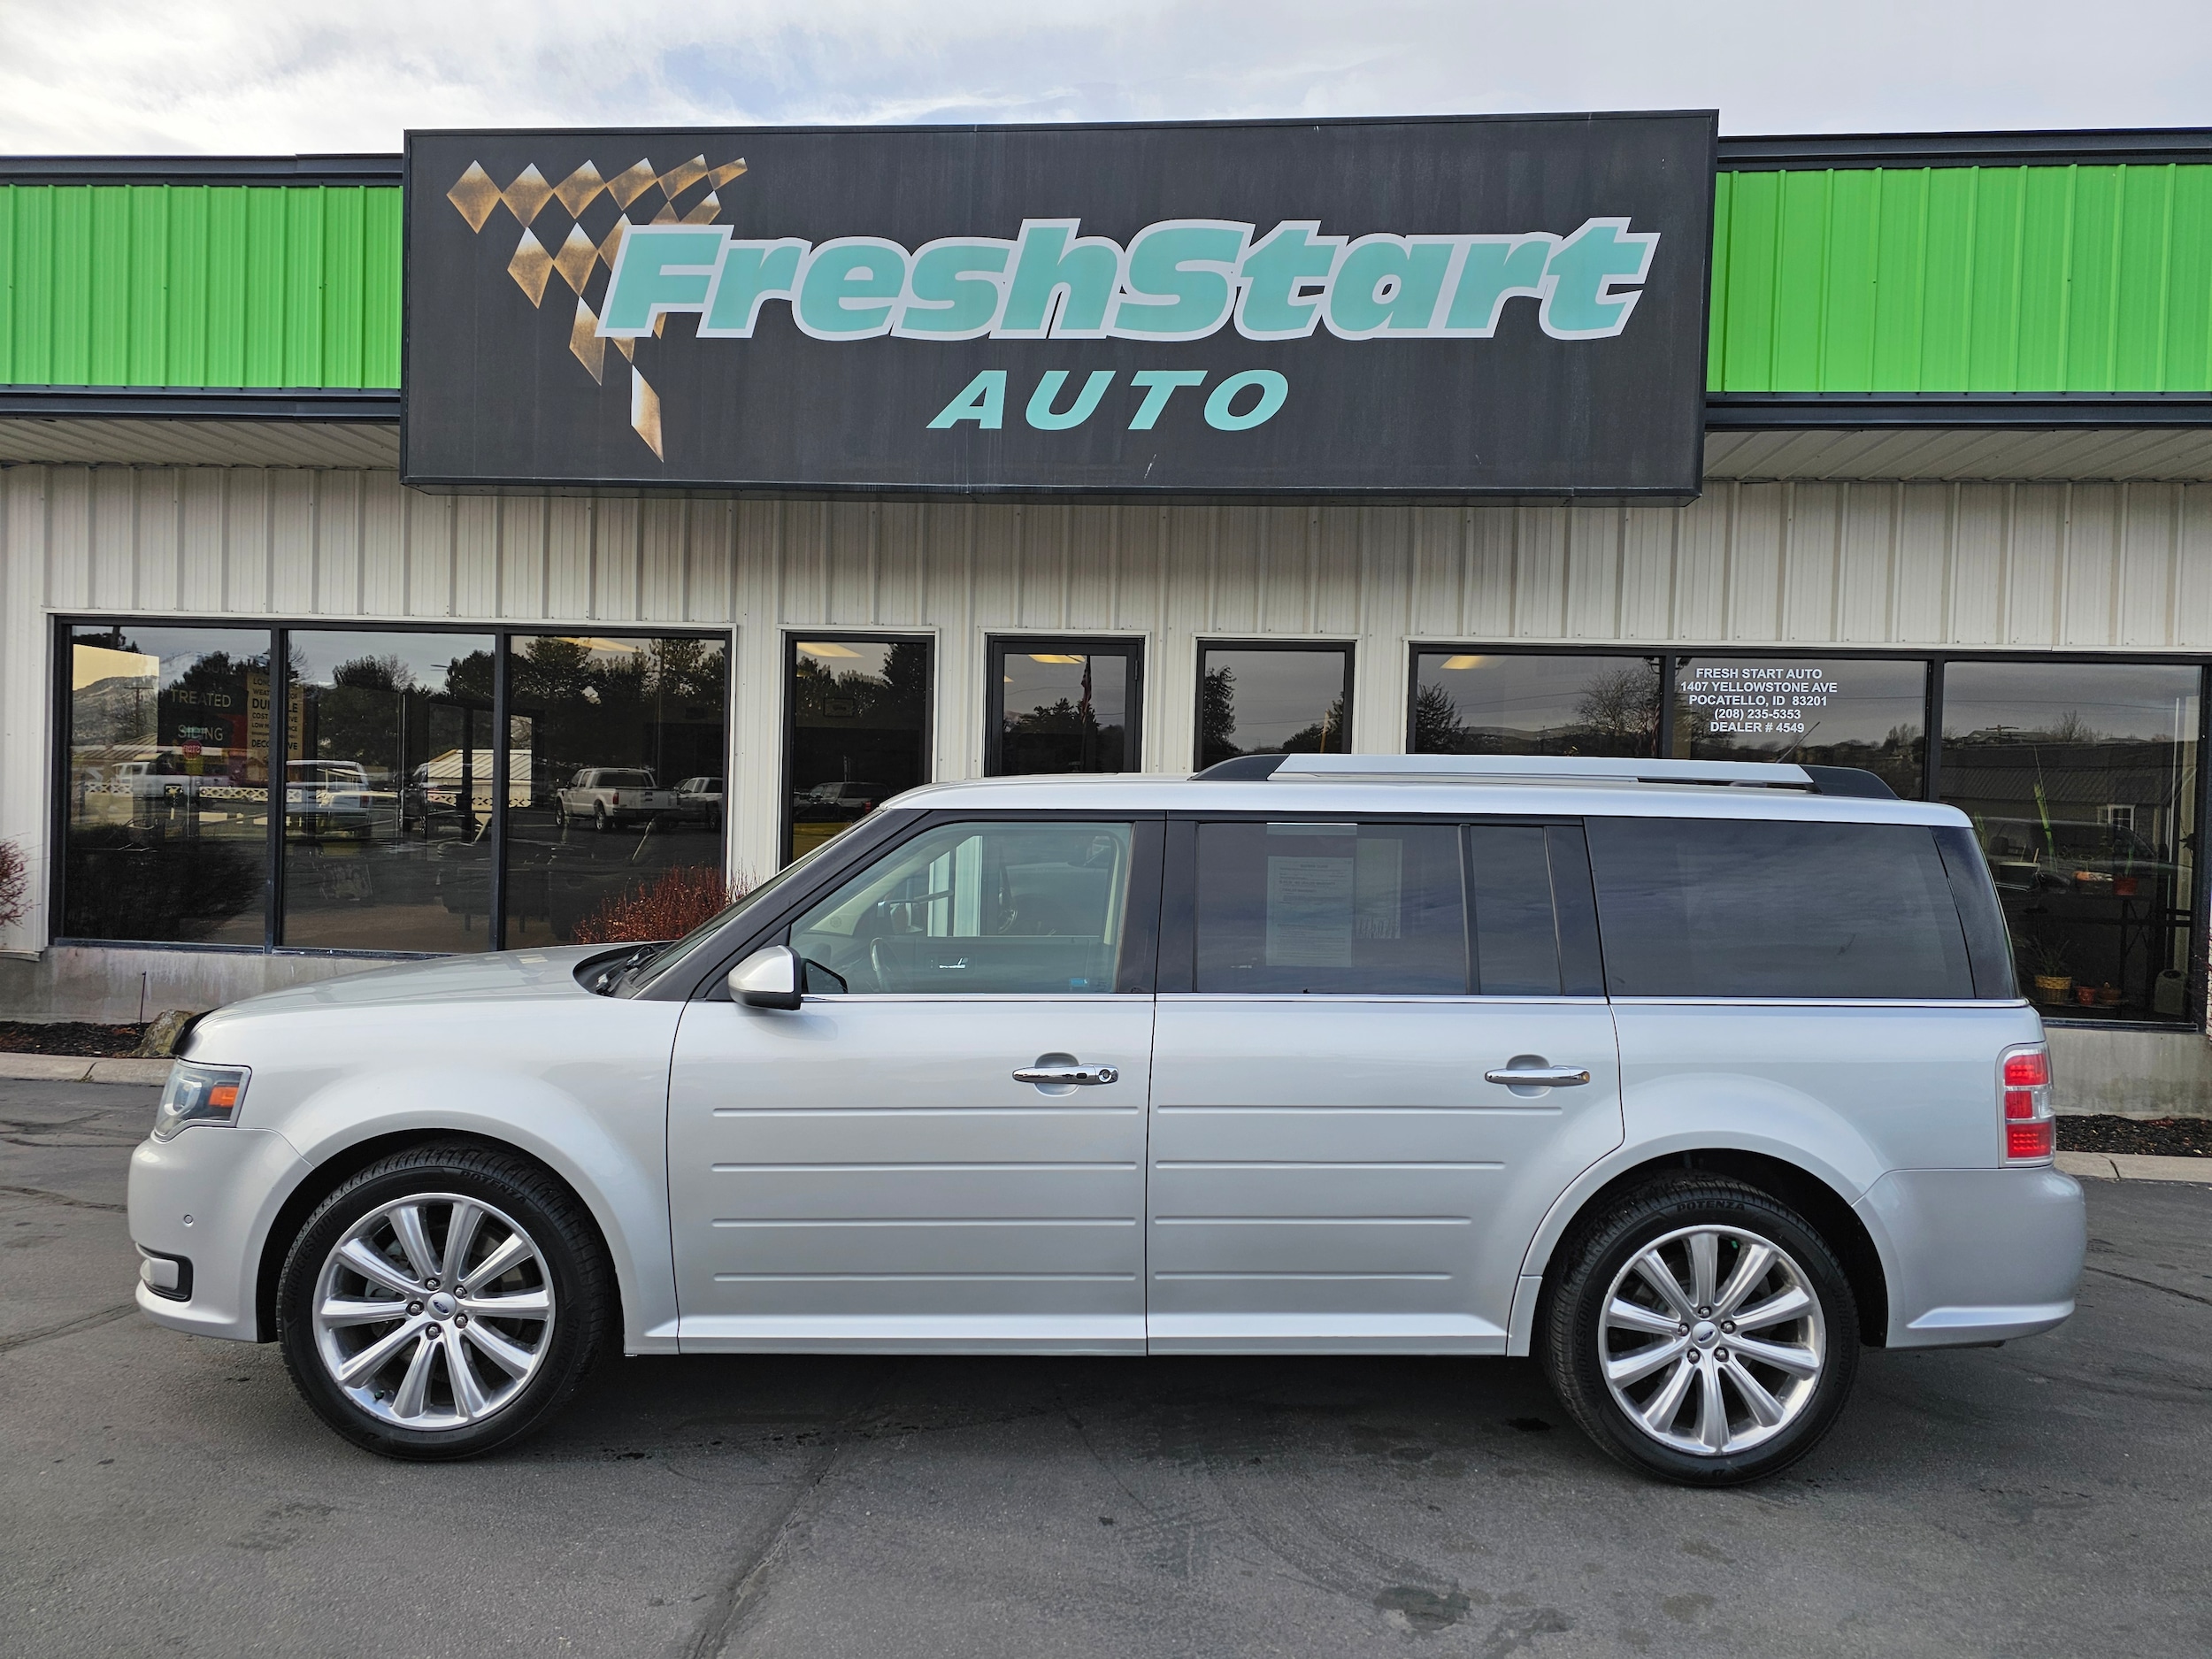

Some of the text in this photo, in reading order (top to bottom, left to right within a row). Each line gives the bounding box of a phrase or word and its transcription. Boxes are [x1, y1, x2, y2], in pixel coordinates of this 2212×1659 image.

[927, 368, 1290, 431] AUTO
[1695, 668, 1823, 680] FRESH START AUTO
[1680, 681, 1838, 693] 1407 YELLOWSTONE AVE
[170, 688, 232, 708] TREATED
[1688, 695, 1828, 708] POCATELLO, ID 83201
[1714, 709, 1801, 721] (208) 235-5353
[178, 724, 223, 741] SIDING
[1709, 722, 1805, 733] DEALER # 4549
[460, 1170, 526, 1204] POTENZA
[1677, 1200, 1745, 1212] POTENZA
